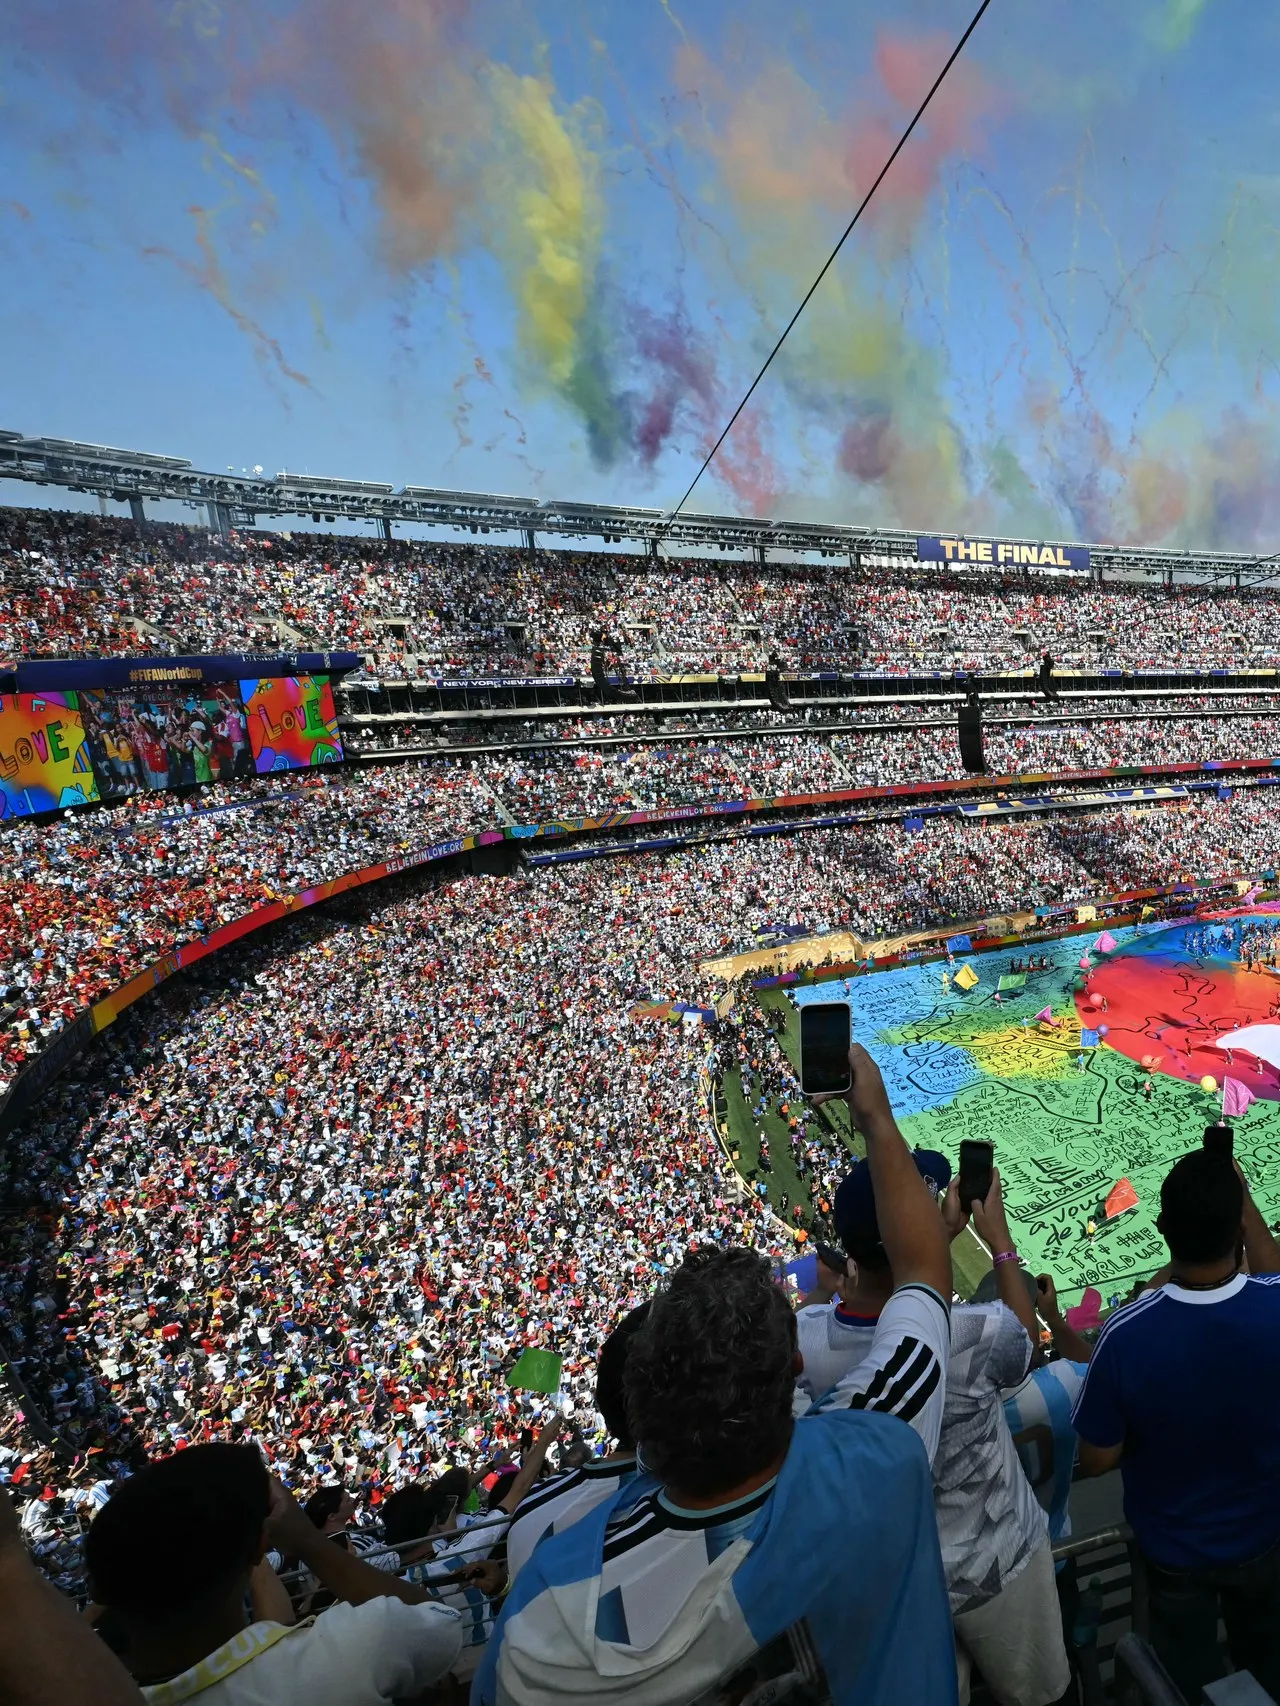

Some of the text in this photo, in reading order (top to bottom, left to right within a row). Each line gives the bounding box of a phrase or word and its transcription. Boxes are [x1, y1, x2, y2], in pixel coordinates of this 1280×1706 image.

[940, 540, 1071, 566] THE FINAL
[129, 666, 203, 682] #FIFAWorldCup
[258, 699, 324, 744] LOVE
[0, 720, 70, 781] LOVE
[646, 804, 724, 820] BELIEVEINLOVE.ORG
[1052, 794, 1078, 803] THE
[385, 840, 465, 873] BELIEVEINLOVE.ORG
[1069, 1256, 1136, 1288] WORLD
